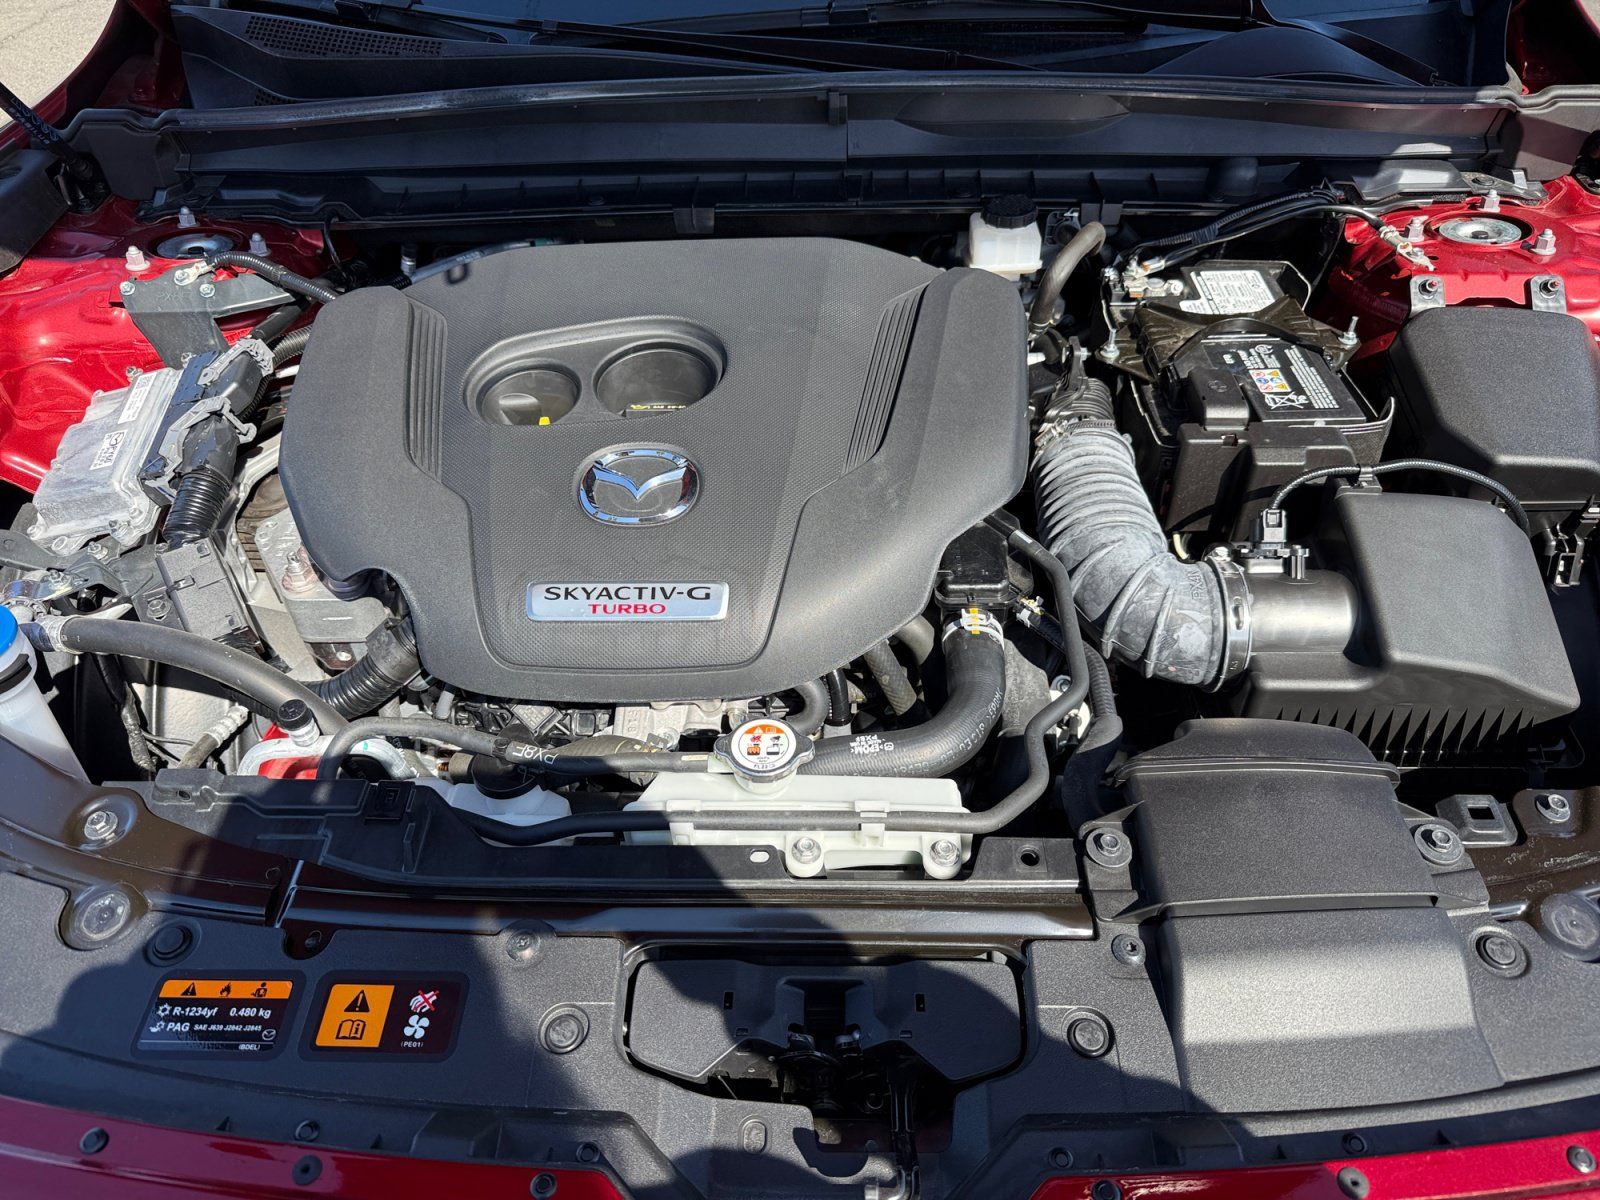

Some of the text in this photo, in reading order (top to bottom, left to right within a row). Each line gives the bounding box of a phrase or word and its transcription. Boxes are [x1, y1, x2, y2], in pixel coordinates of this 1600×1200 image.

[543, 586, 711, 601] SKYACTIV-G
[588, 603, 667, 615] TURBO
[172, 1006, 272, 1019] R-1234yf 0.480 kg
[166, 1022, 190, 1032] PAG
